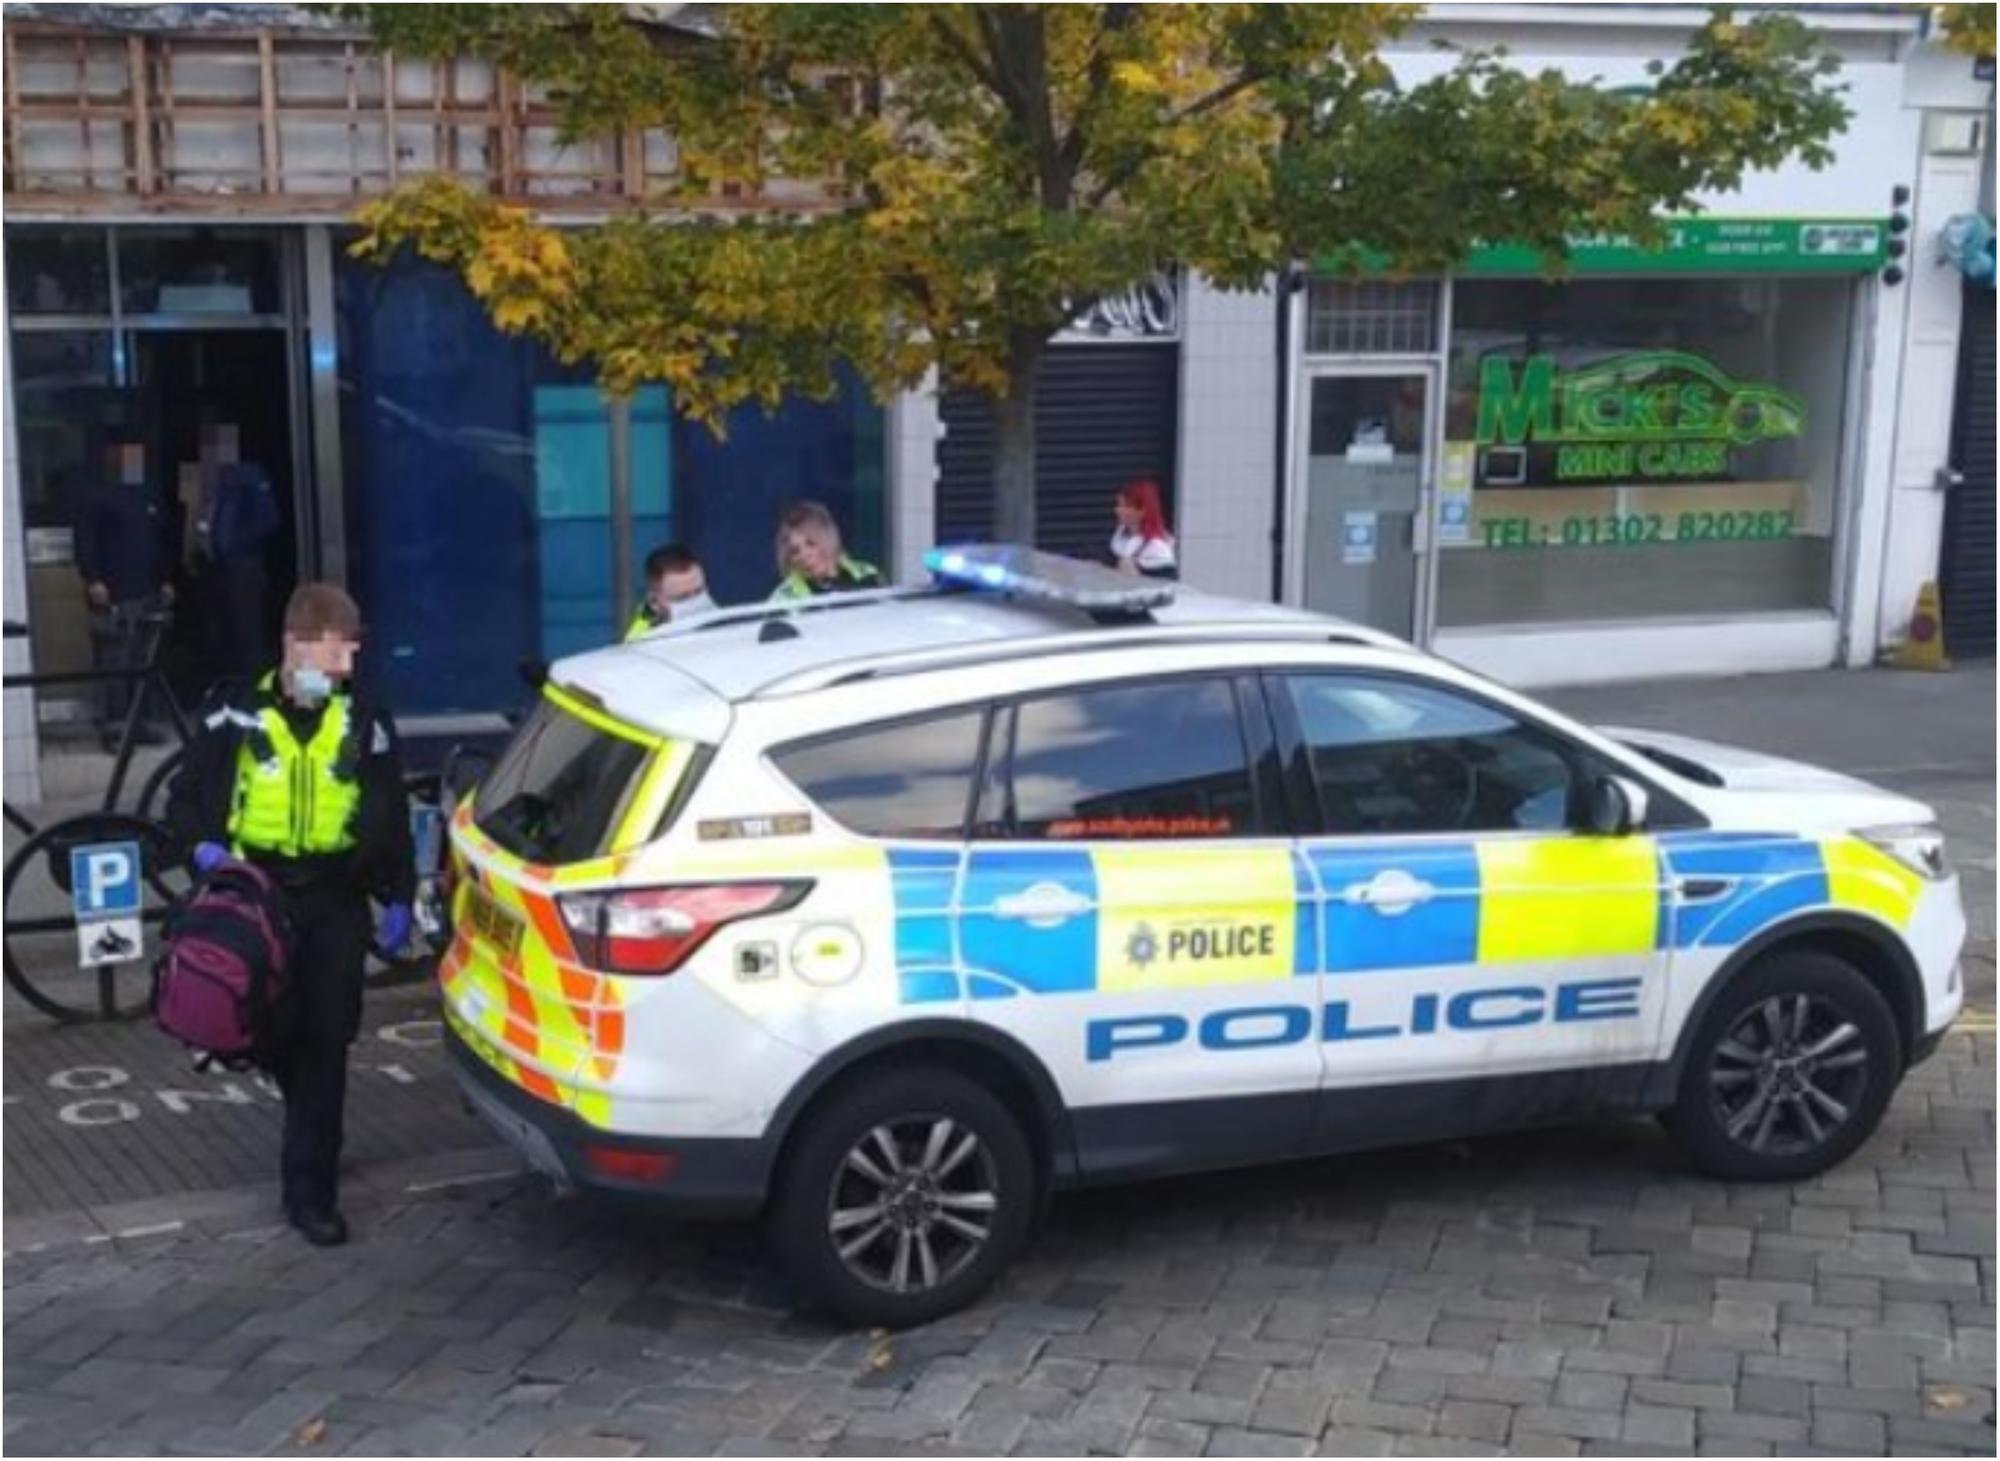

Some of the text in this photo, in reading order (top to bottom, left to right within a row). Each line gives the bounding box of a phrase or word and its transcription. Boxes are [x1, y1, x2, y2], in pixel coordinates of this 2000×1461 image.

[1556, 441, 1729, 480] MINI CABS
[1481, 509, 1797, 550] TEL: 01302 820282
[88, 852, 130, 907] P
[1166, 924, 1275, 962] POLICE
[1084, 976, 1643, 1062] POLICE
